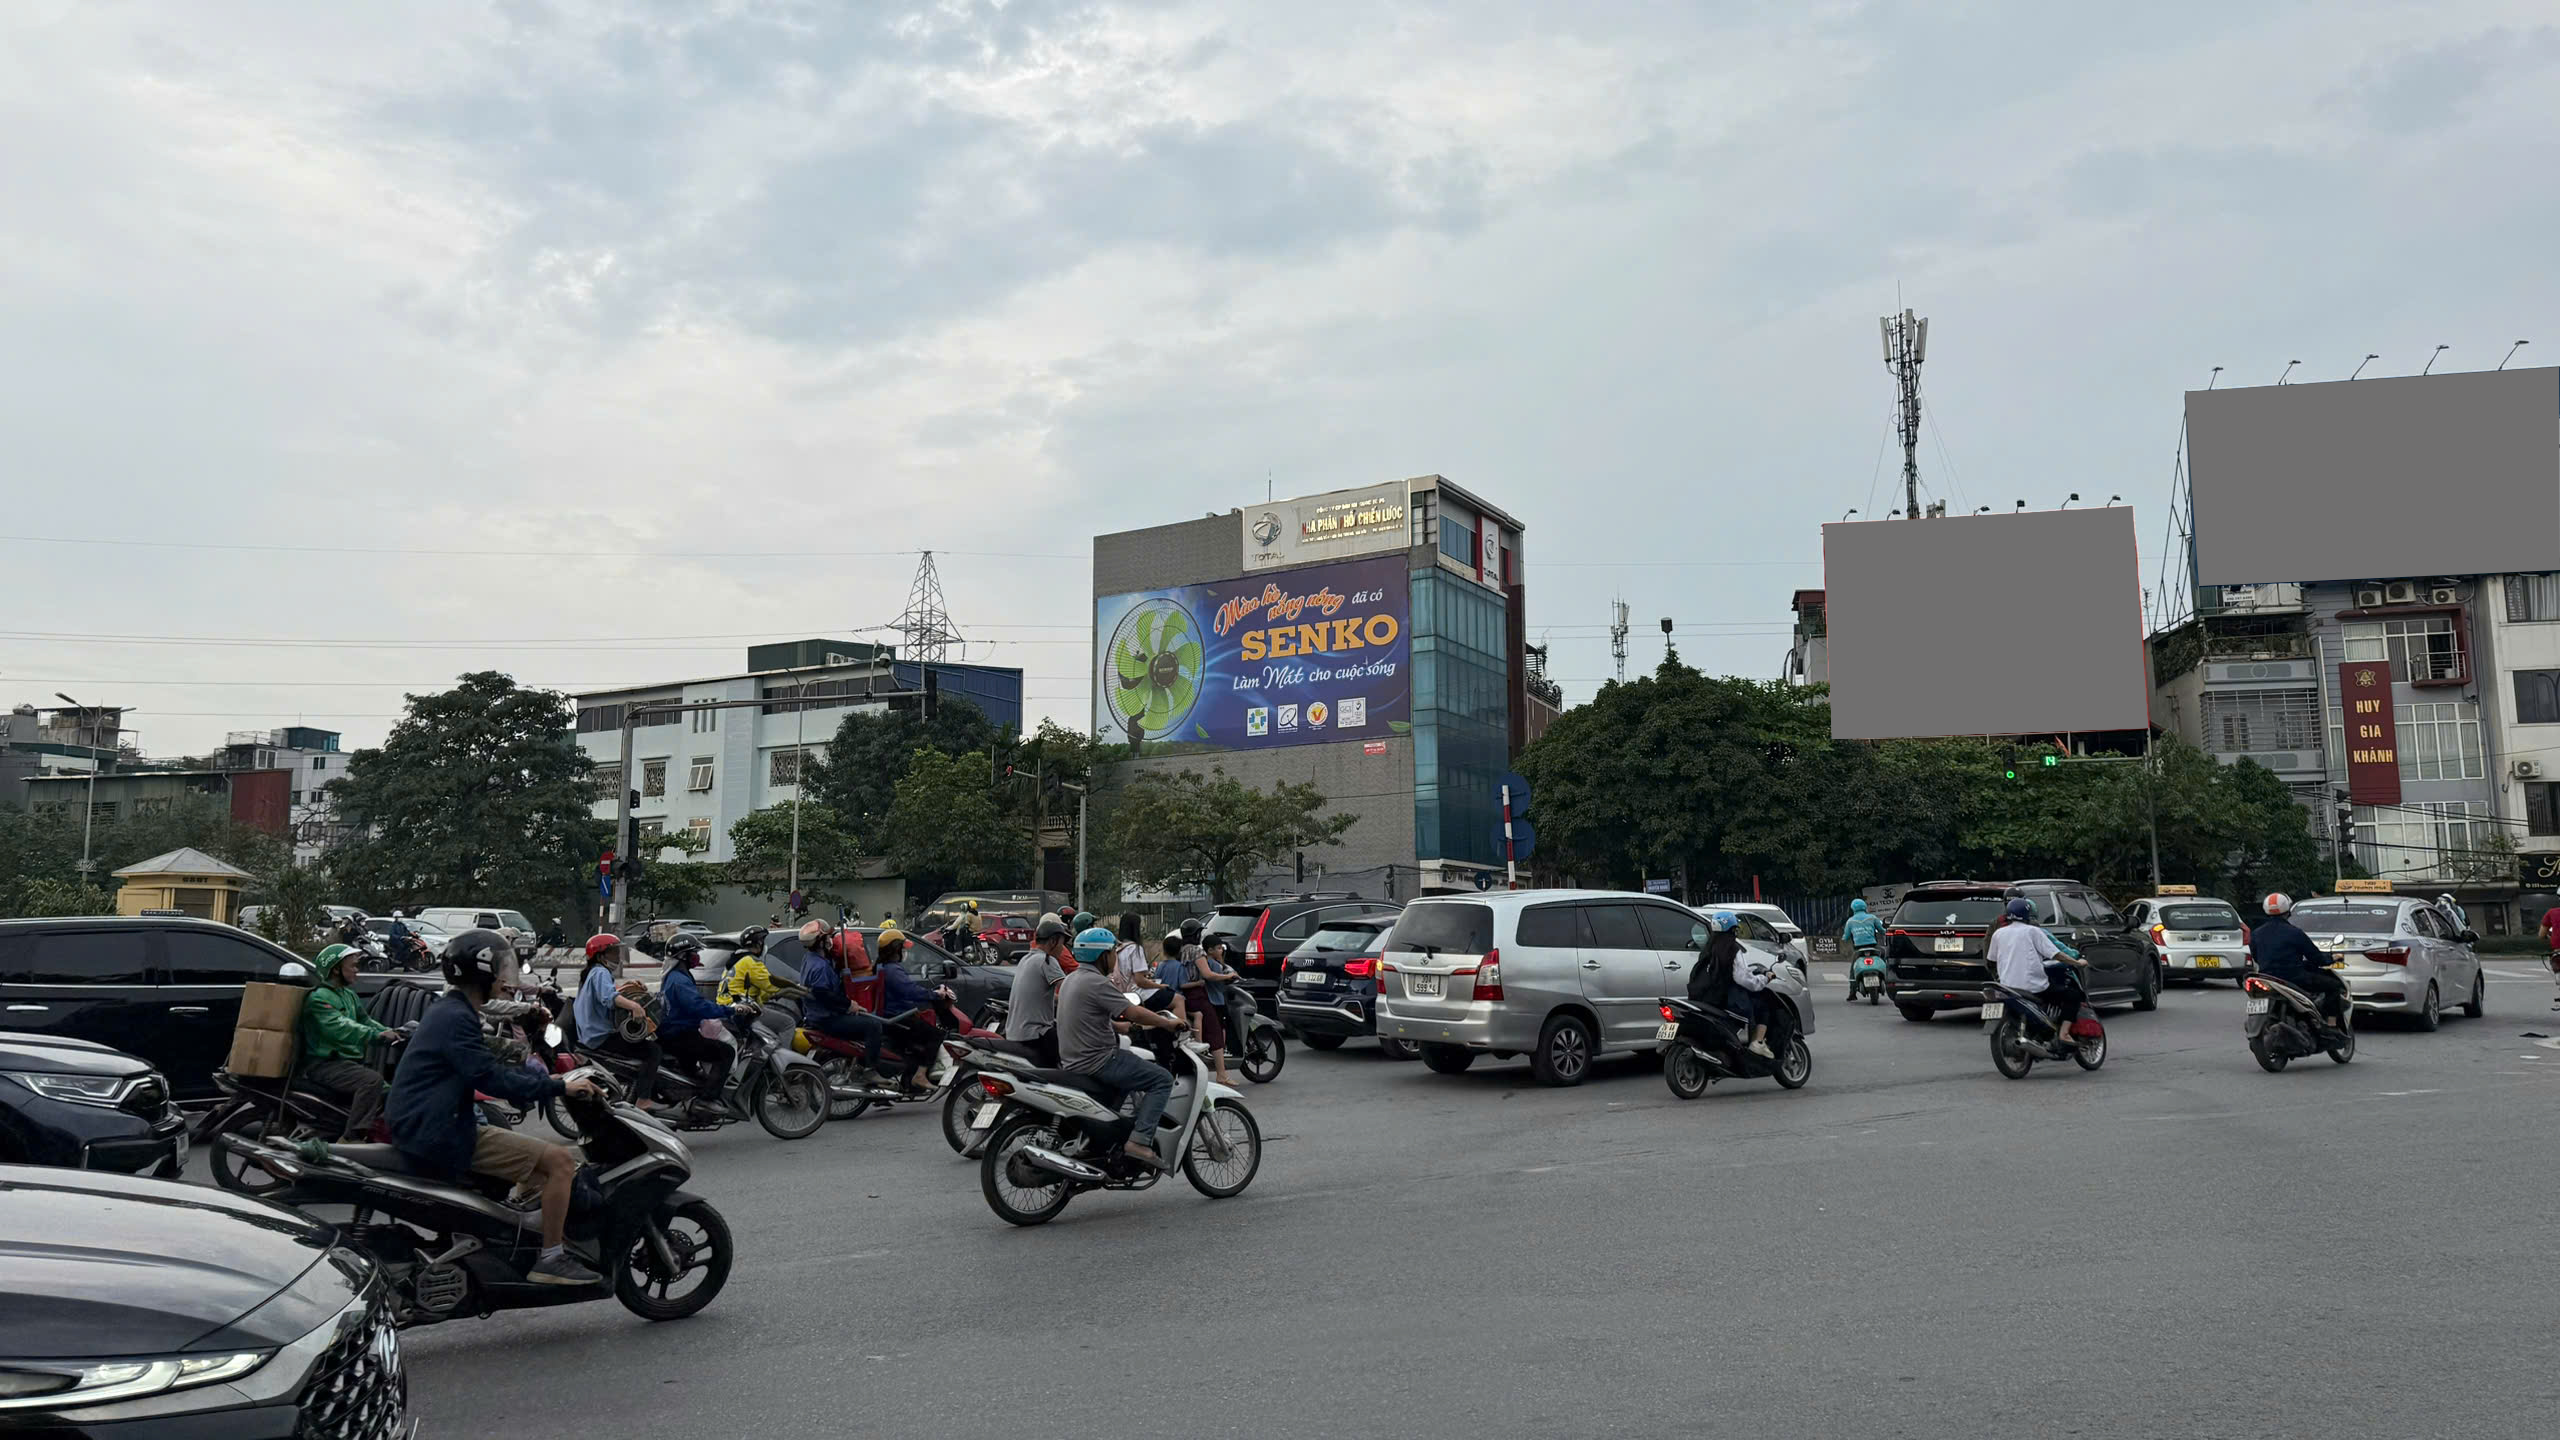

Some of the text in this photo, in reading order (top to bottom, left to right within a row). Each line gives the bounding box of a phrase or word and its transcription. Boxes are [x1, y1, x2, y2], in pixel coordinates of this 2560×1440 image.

[1213, 595, 1260, 636] Mùa
[1305, 587, 1345, 616] nóng
[1352, 590, 1368, 604] đã
[1370, 588, 1383, 601] có
[1241, 613, 1399, 662] SENKO
[1233, 660, 1396, 690] Làm Mát cho cuộc sống
[2356, 699, 2380, 713] HUY
[2360, 724, 2382, 738] GIA
[2353, 746, 2393, 763] KHÁNH
